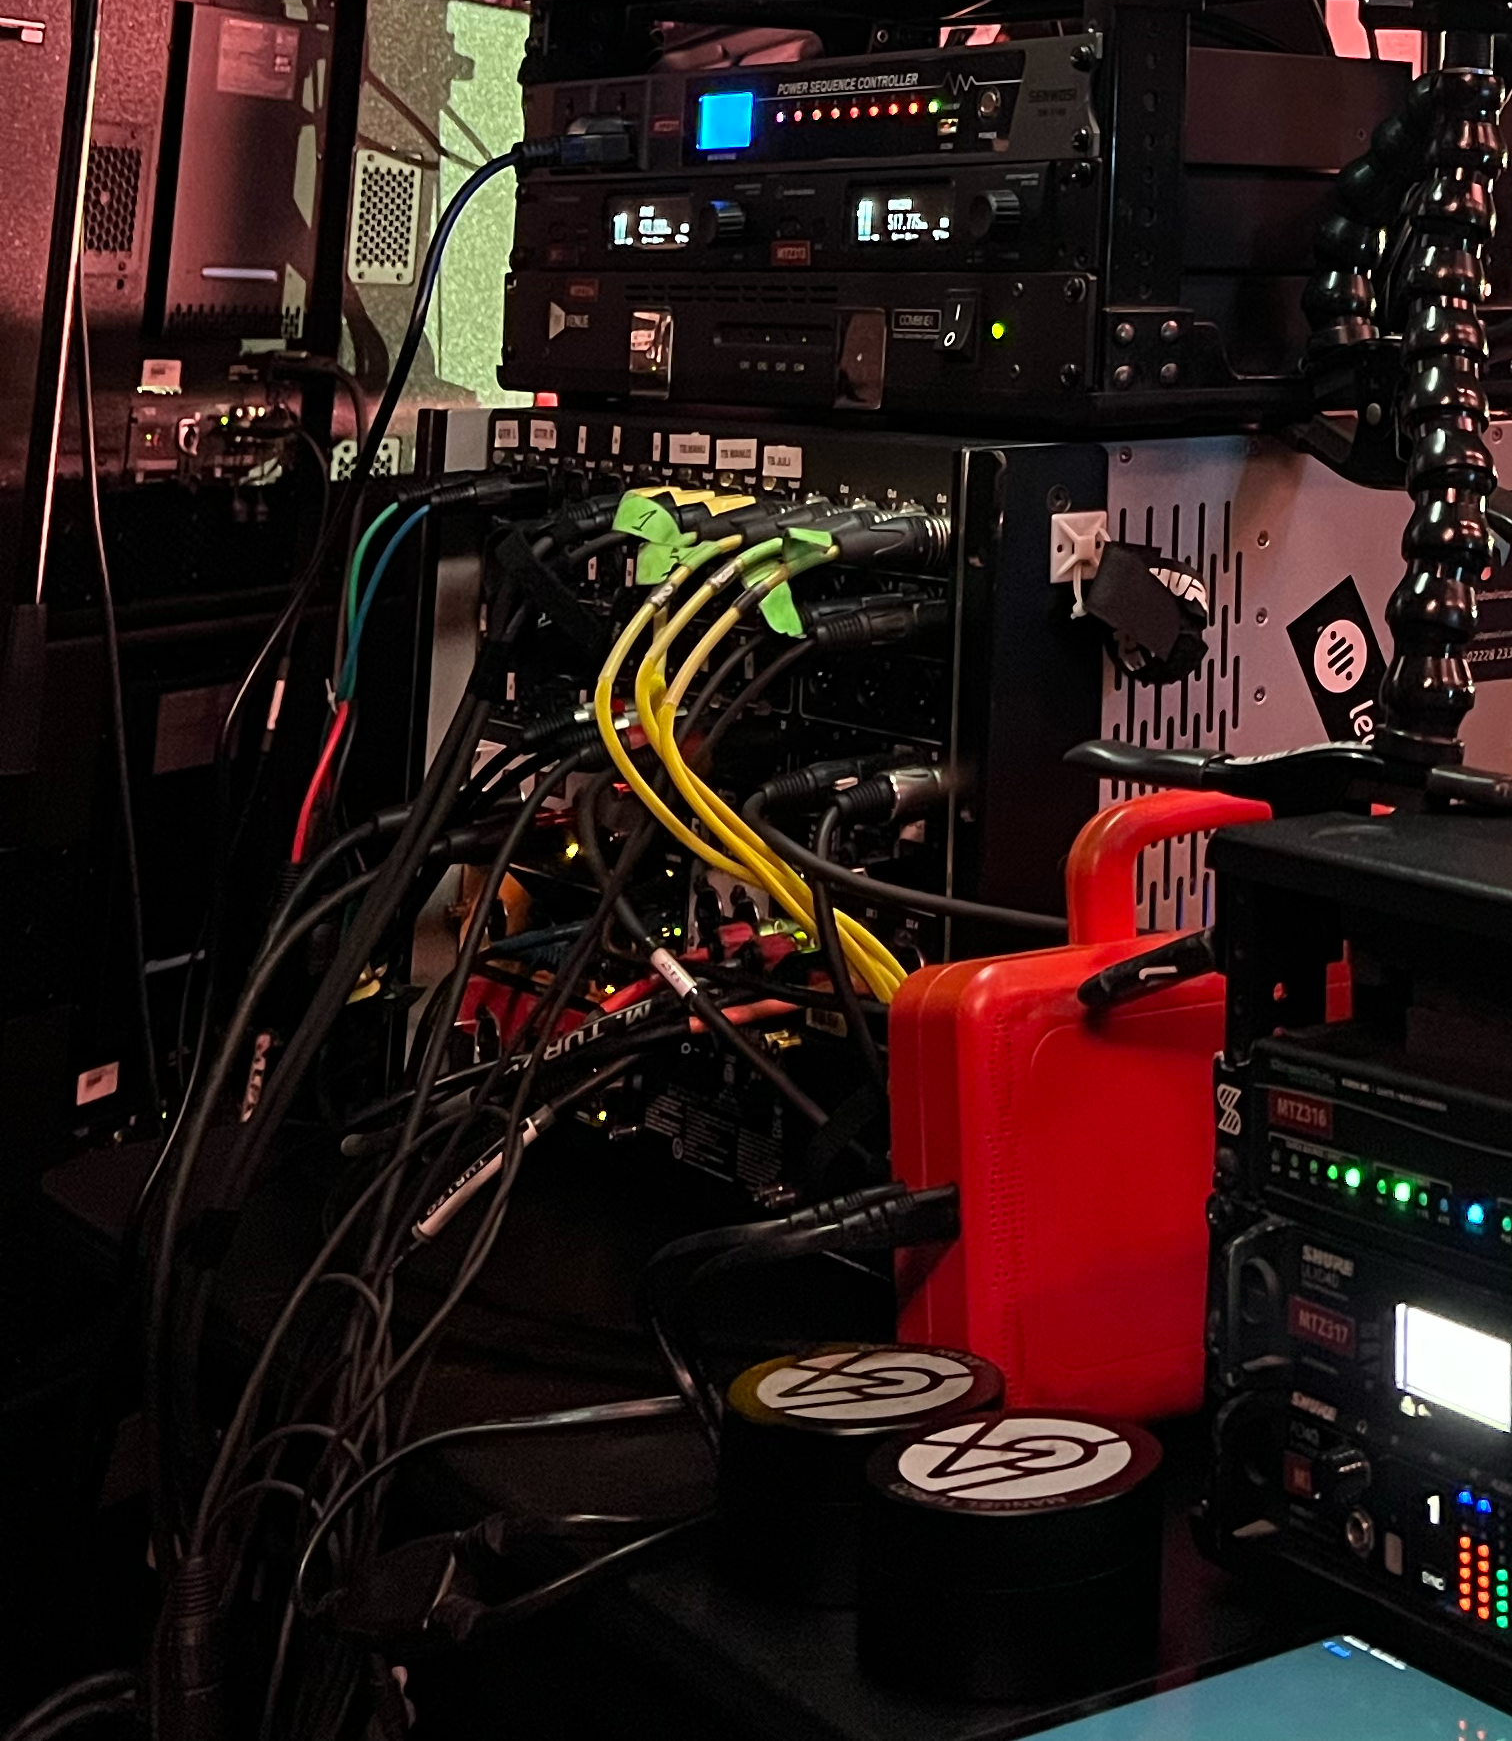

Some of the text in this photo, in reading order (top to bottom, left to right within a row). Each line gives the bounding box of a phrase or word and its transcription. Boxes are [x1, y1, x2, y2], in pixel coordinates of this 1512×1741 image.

[777, 73, 919, 95] POWER SEQUENCE CONTROLLER
[632, 509, 658, 532] 1
[1276, 1096, 1327, 1128] MTZ316
[1302, 1244, 1355, 1278] SHURE
[1298, 1307, 1349, 1344] MTZ317
[1427, 1495, 1440, 1526] 1
